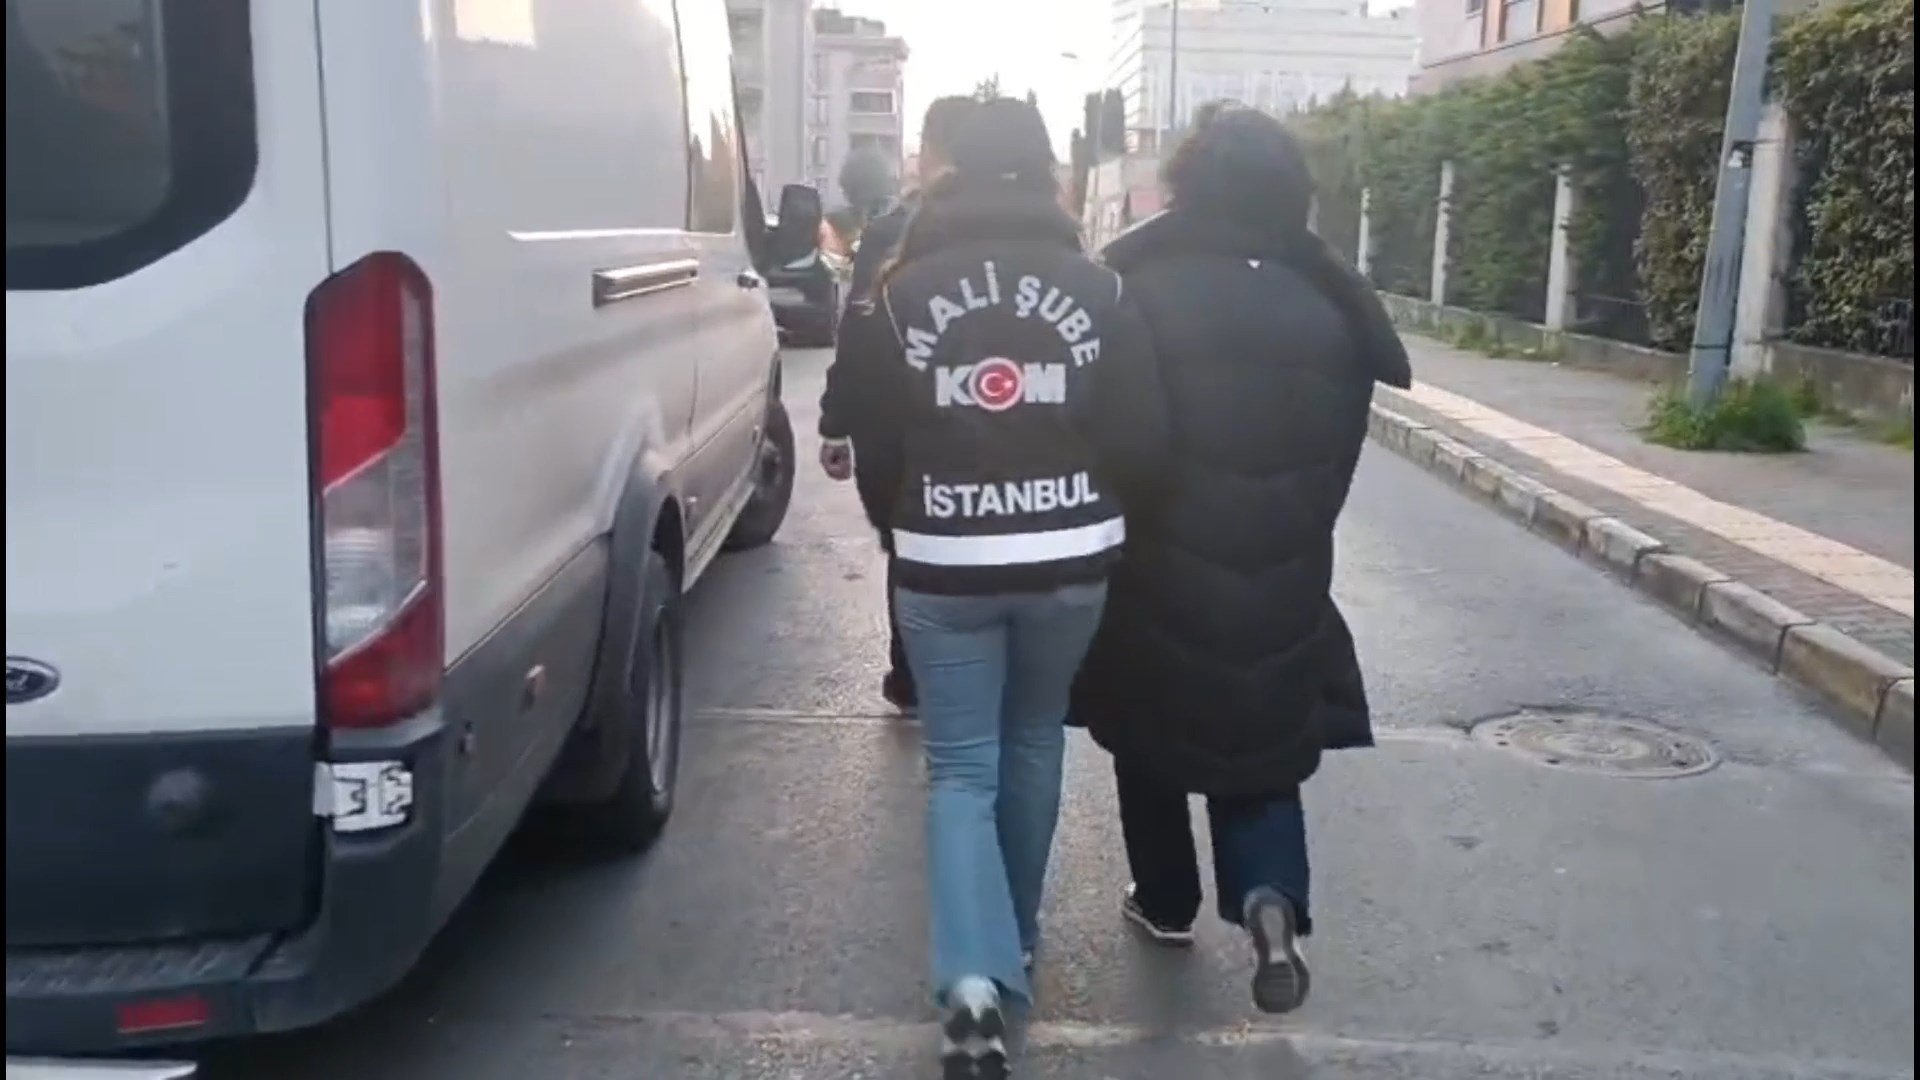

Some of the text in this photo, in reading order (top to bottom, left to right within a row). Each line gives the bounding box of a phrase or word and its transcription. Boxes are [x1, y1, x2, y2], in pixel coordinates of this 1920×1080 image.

[904, 260, 1101, 372] MALİ ŞUBE
[935, 357, 1066, 412] KOM
[922, 470, 1099, 519] İSTANBUL
